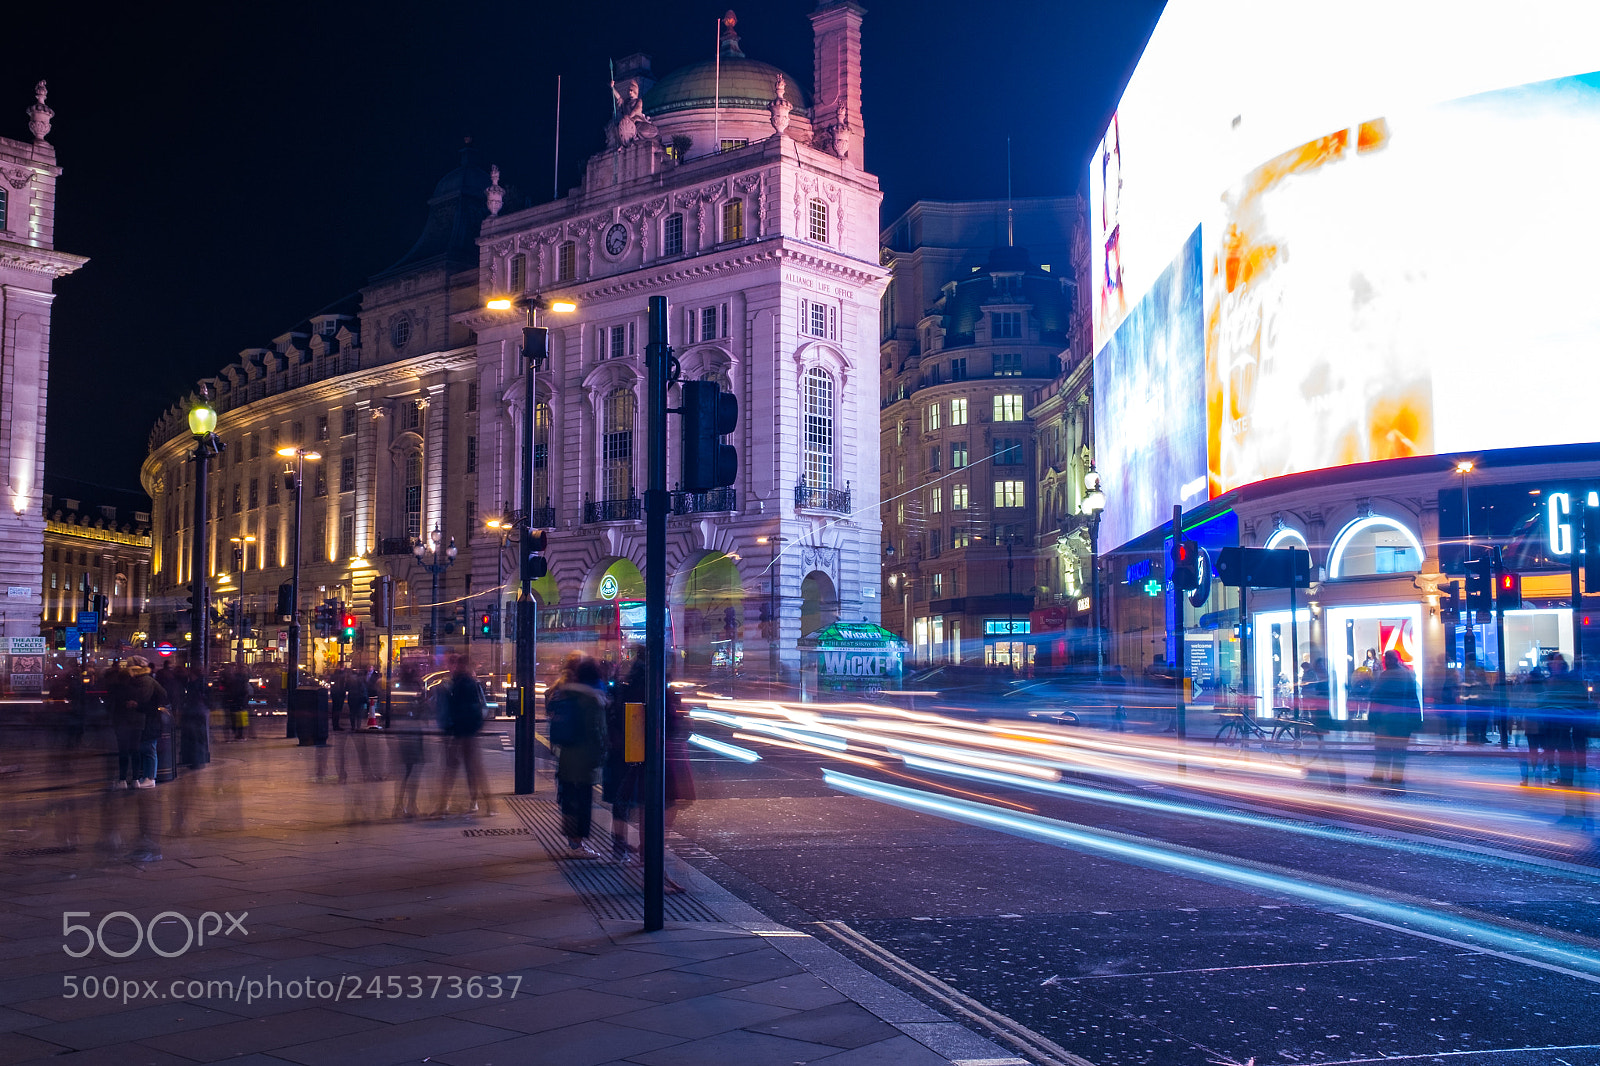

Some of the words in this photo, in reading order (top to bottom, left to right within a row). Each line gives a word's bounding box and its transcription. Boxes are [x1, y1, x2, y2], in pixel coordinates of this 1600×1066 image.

[785, 273, 813, 288] ALLIANCE
[818, 282, 830, 293] LIFE
[834, 287, 854, 299] OFFICE
[628, 633, 646, 641] Aldwyc
[838, 630, 882, 639] WICKED
